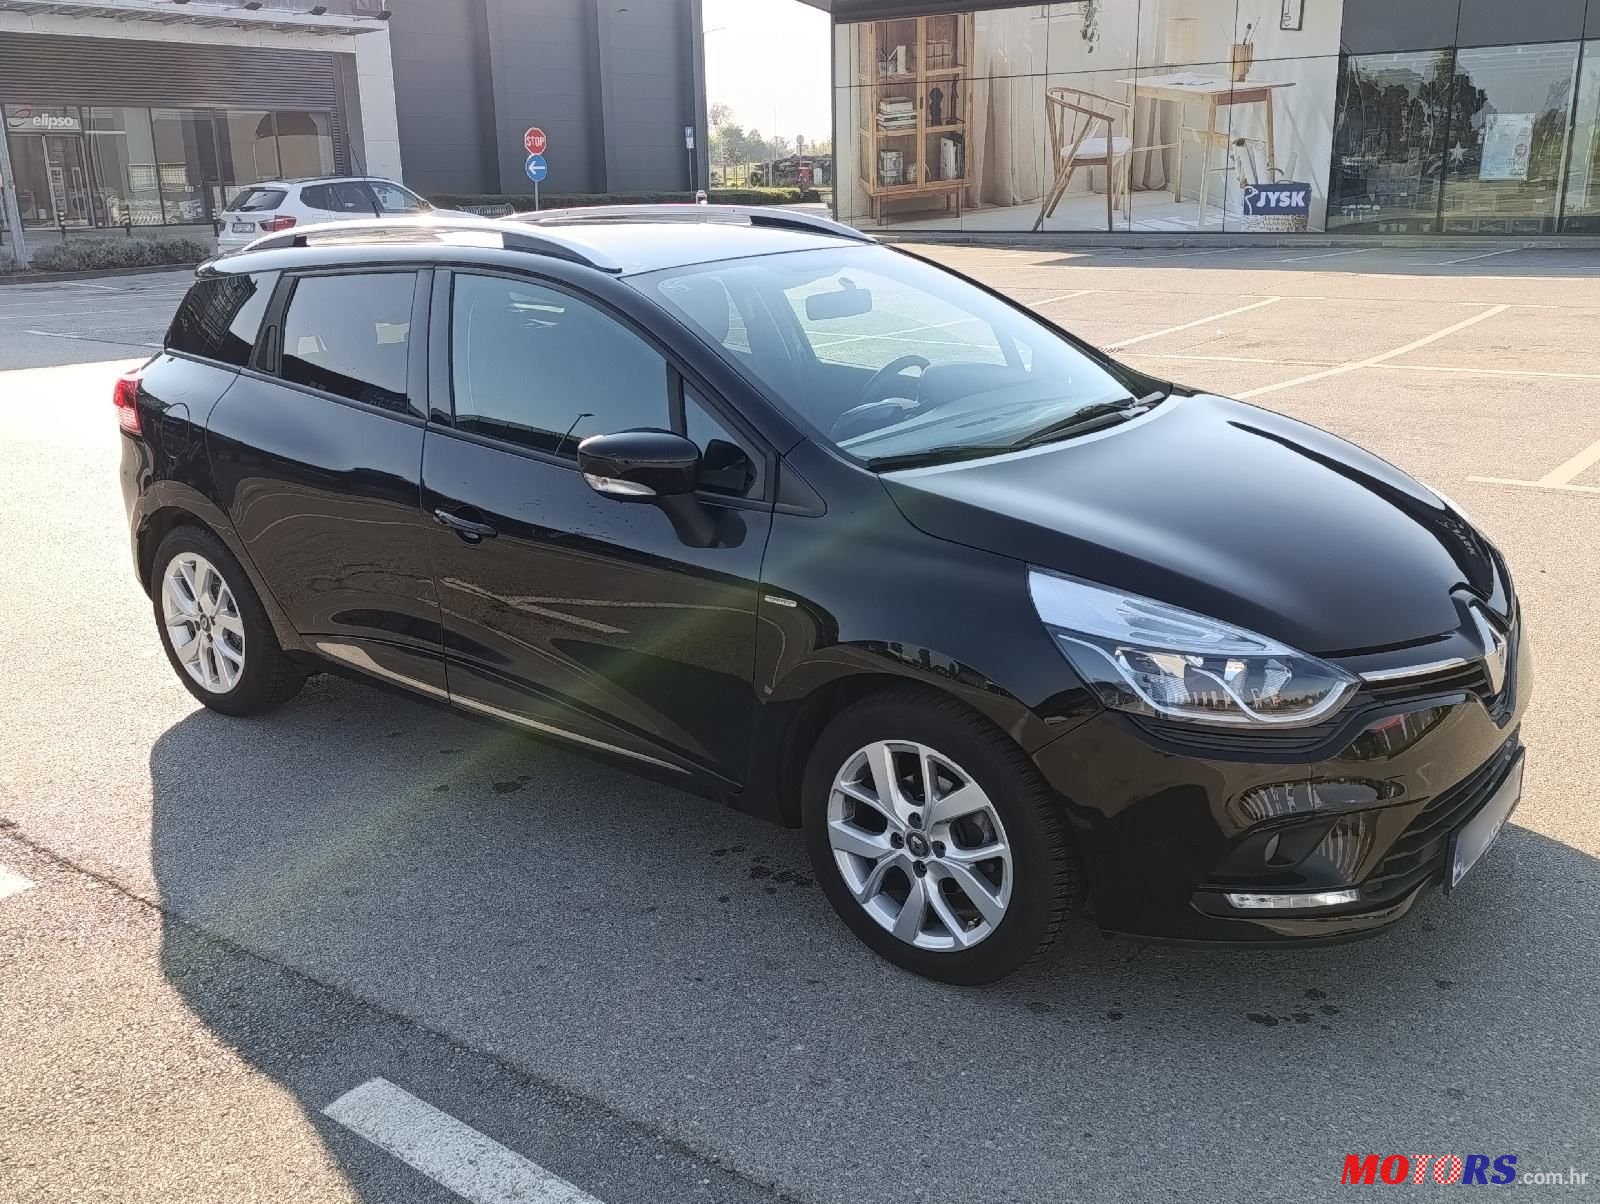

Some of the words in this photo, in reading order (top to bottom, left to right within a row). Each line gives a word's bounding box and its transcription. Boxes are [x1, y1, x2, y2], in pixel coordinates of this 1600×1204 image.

[32, 113, 74, 130] elipso
[526, 136, 545, 147] STOP
[1256, 191, 1306, 207] JYSK
